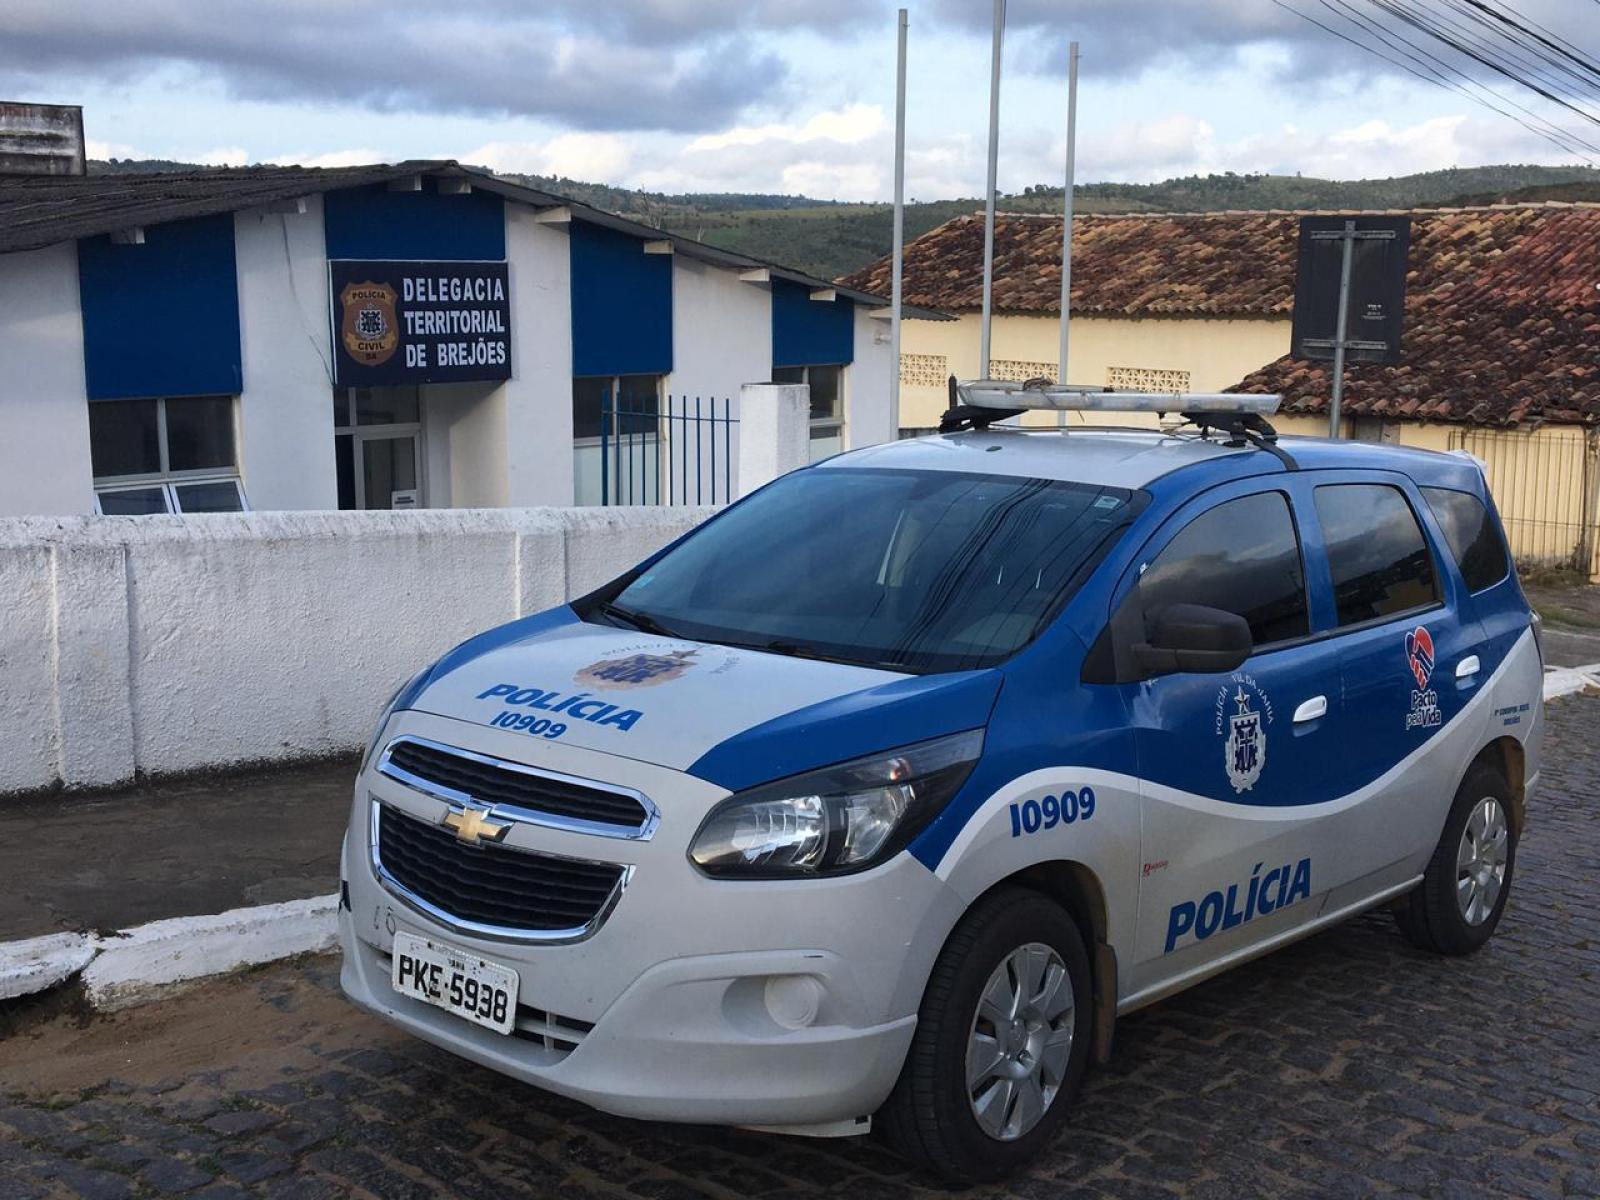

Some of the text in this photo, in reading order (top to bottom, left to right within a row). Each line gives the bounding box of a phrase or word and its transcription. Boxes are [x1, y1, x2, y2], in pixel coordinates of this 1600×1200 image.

[403, 277, 505, 302] DELEGACIA
[404, 310, 506, 335] TERRITORIAL
[358, 341, 385, 351] CIVIL
[406, 337, 506, 368] DE BREJÕES
[475, 683, 644, 732] POLÍCIA
[1411, 689, 1437, 709] Pacto
[490, 711, 568, 739] 10909
[1009, 786, 1096, 838] 10909
[1164, 857, 1312, 954] POLÍCIA
